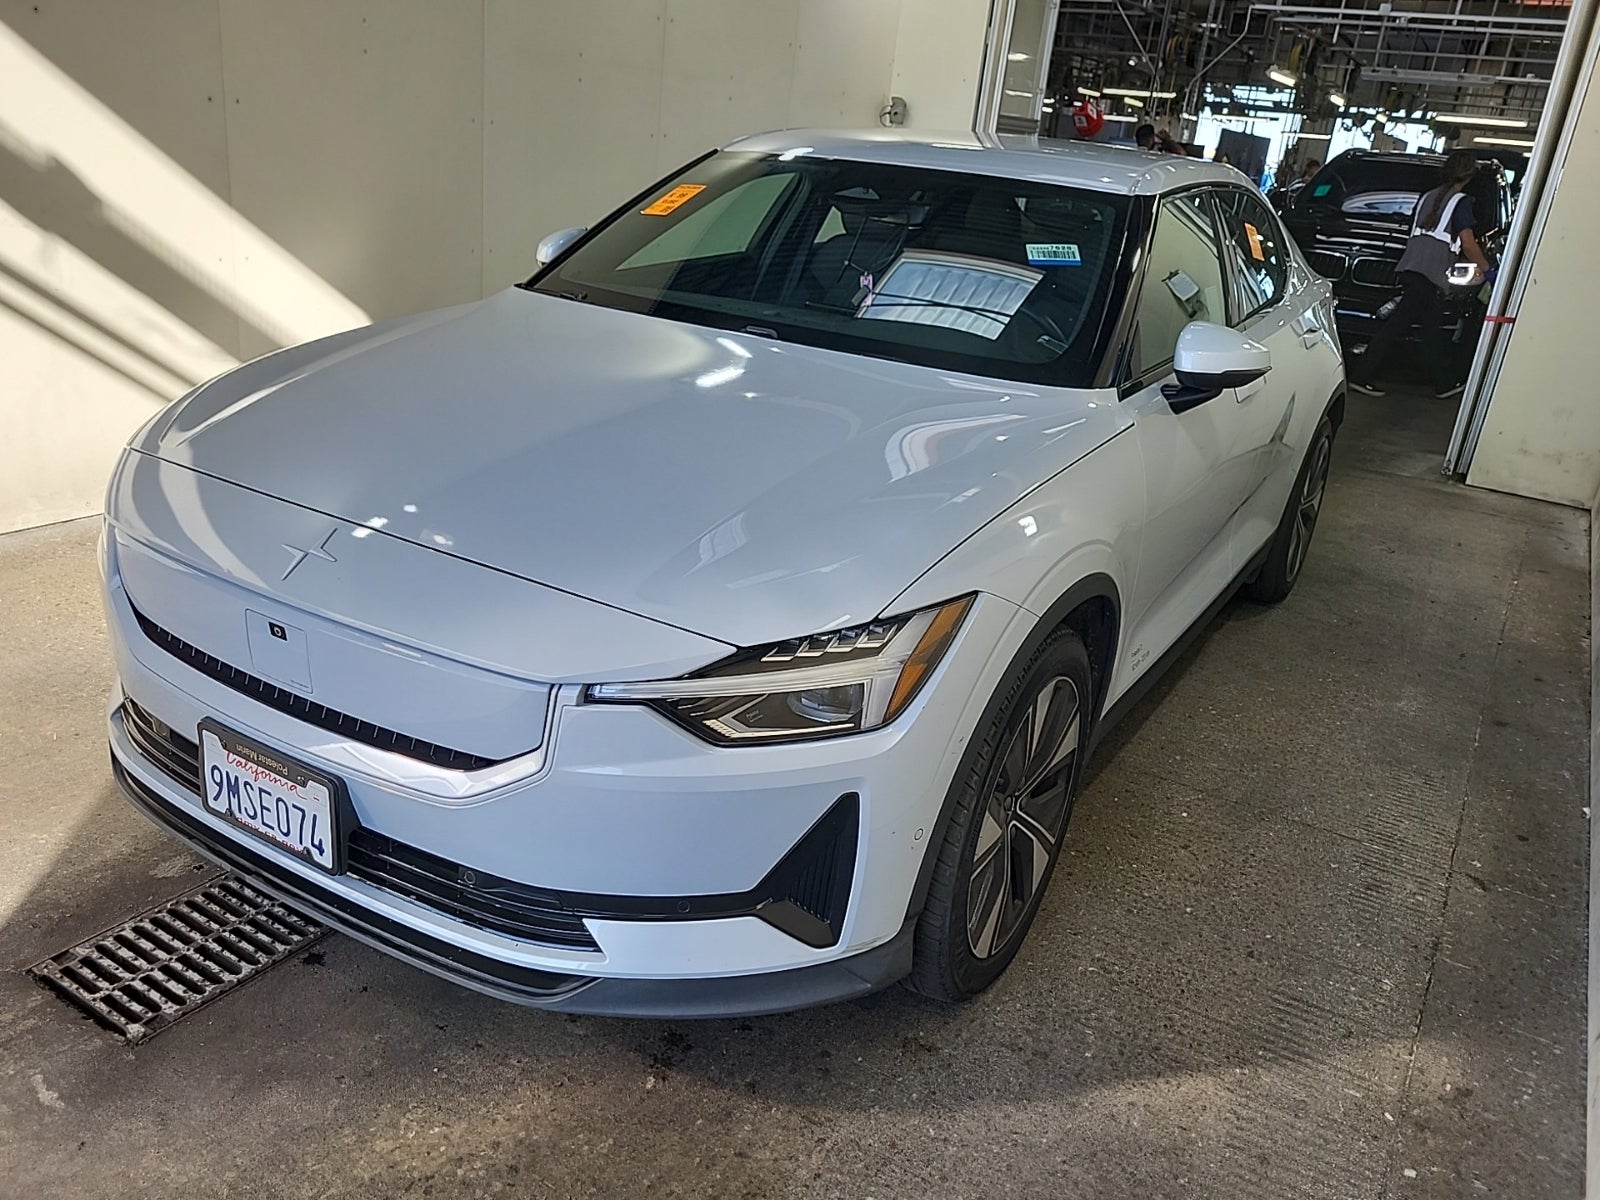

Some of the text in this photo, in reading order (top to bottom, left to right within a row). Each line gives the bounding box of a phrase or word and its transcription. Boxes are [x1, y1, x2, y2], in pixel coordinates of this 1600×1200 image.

[226, 750, 307, 801] California
[235, 743, 289, 776] Polestar Marin
[210, 764, 325, 857] 9MSE074
